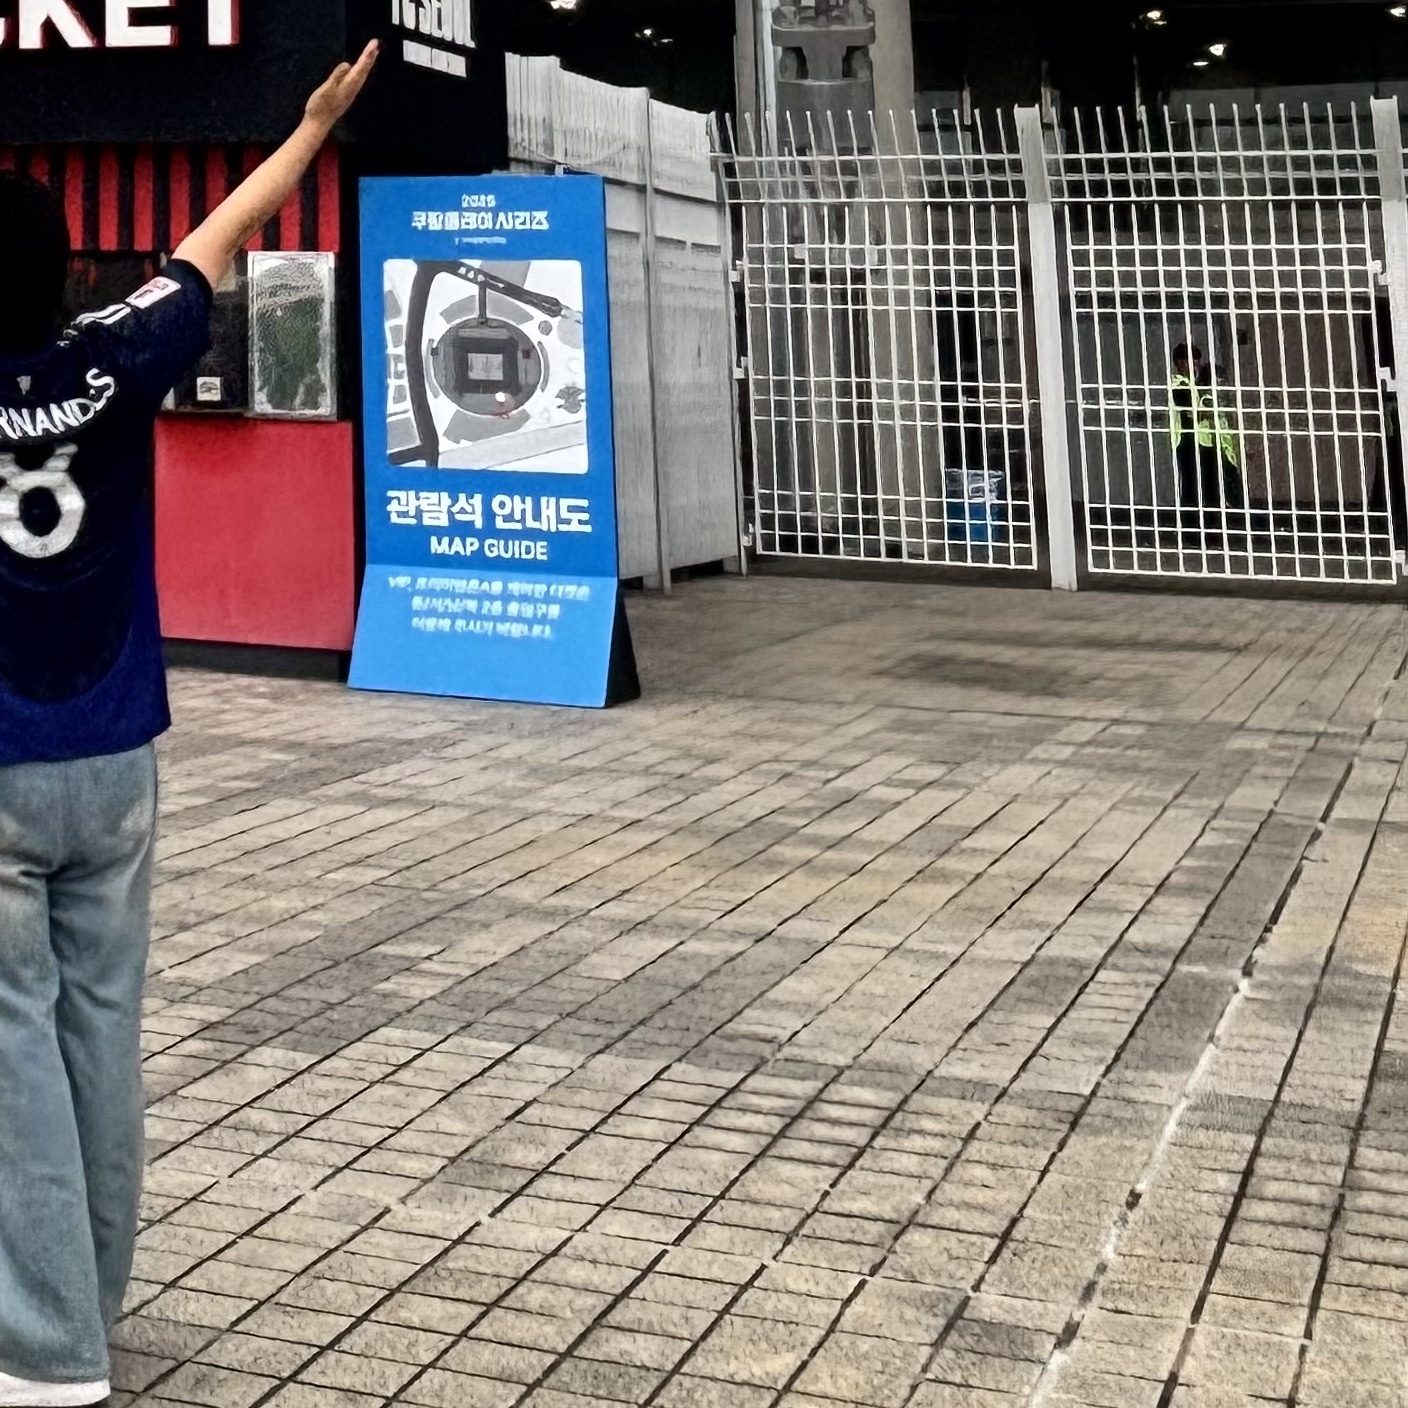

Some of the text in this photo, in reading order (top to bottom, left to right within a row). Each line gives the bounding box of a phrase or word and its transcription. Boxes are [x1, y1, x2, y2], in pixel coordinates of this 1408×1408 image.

[495, 210, 550, 230] 시리즈
[386, 490, 592, 533] 관람석 안내도
[430, 535, 549, 561] MAP GUIDE
